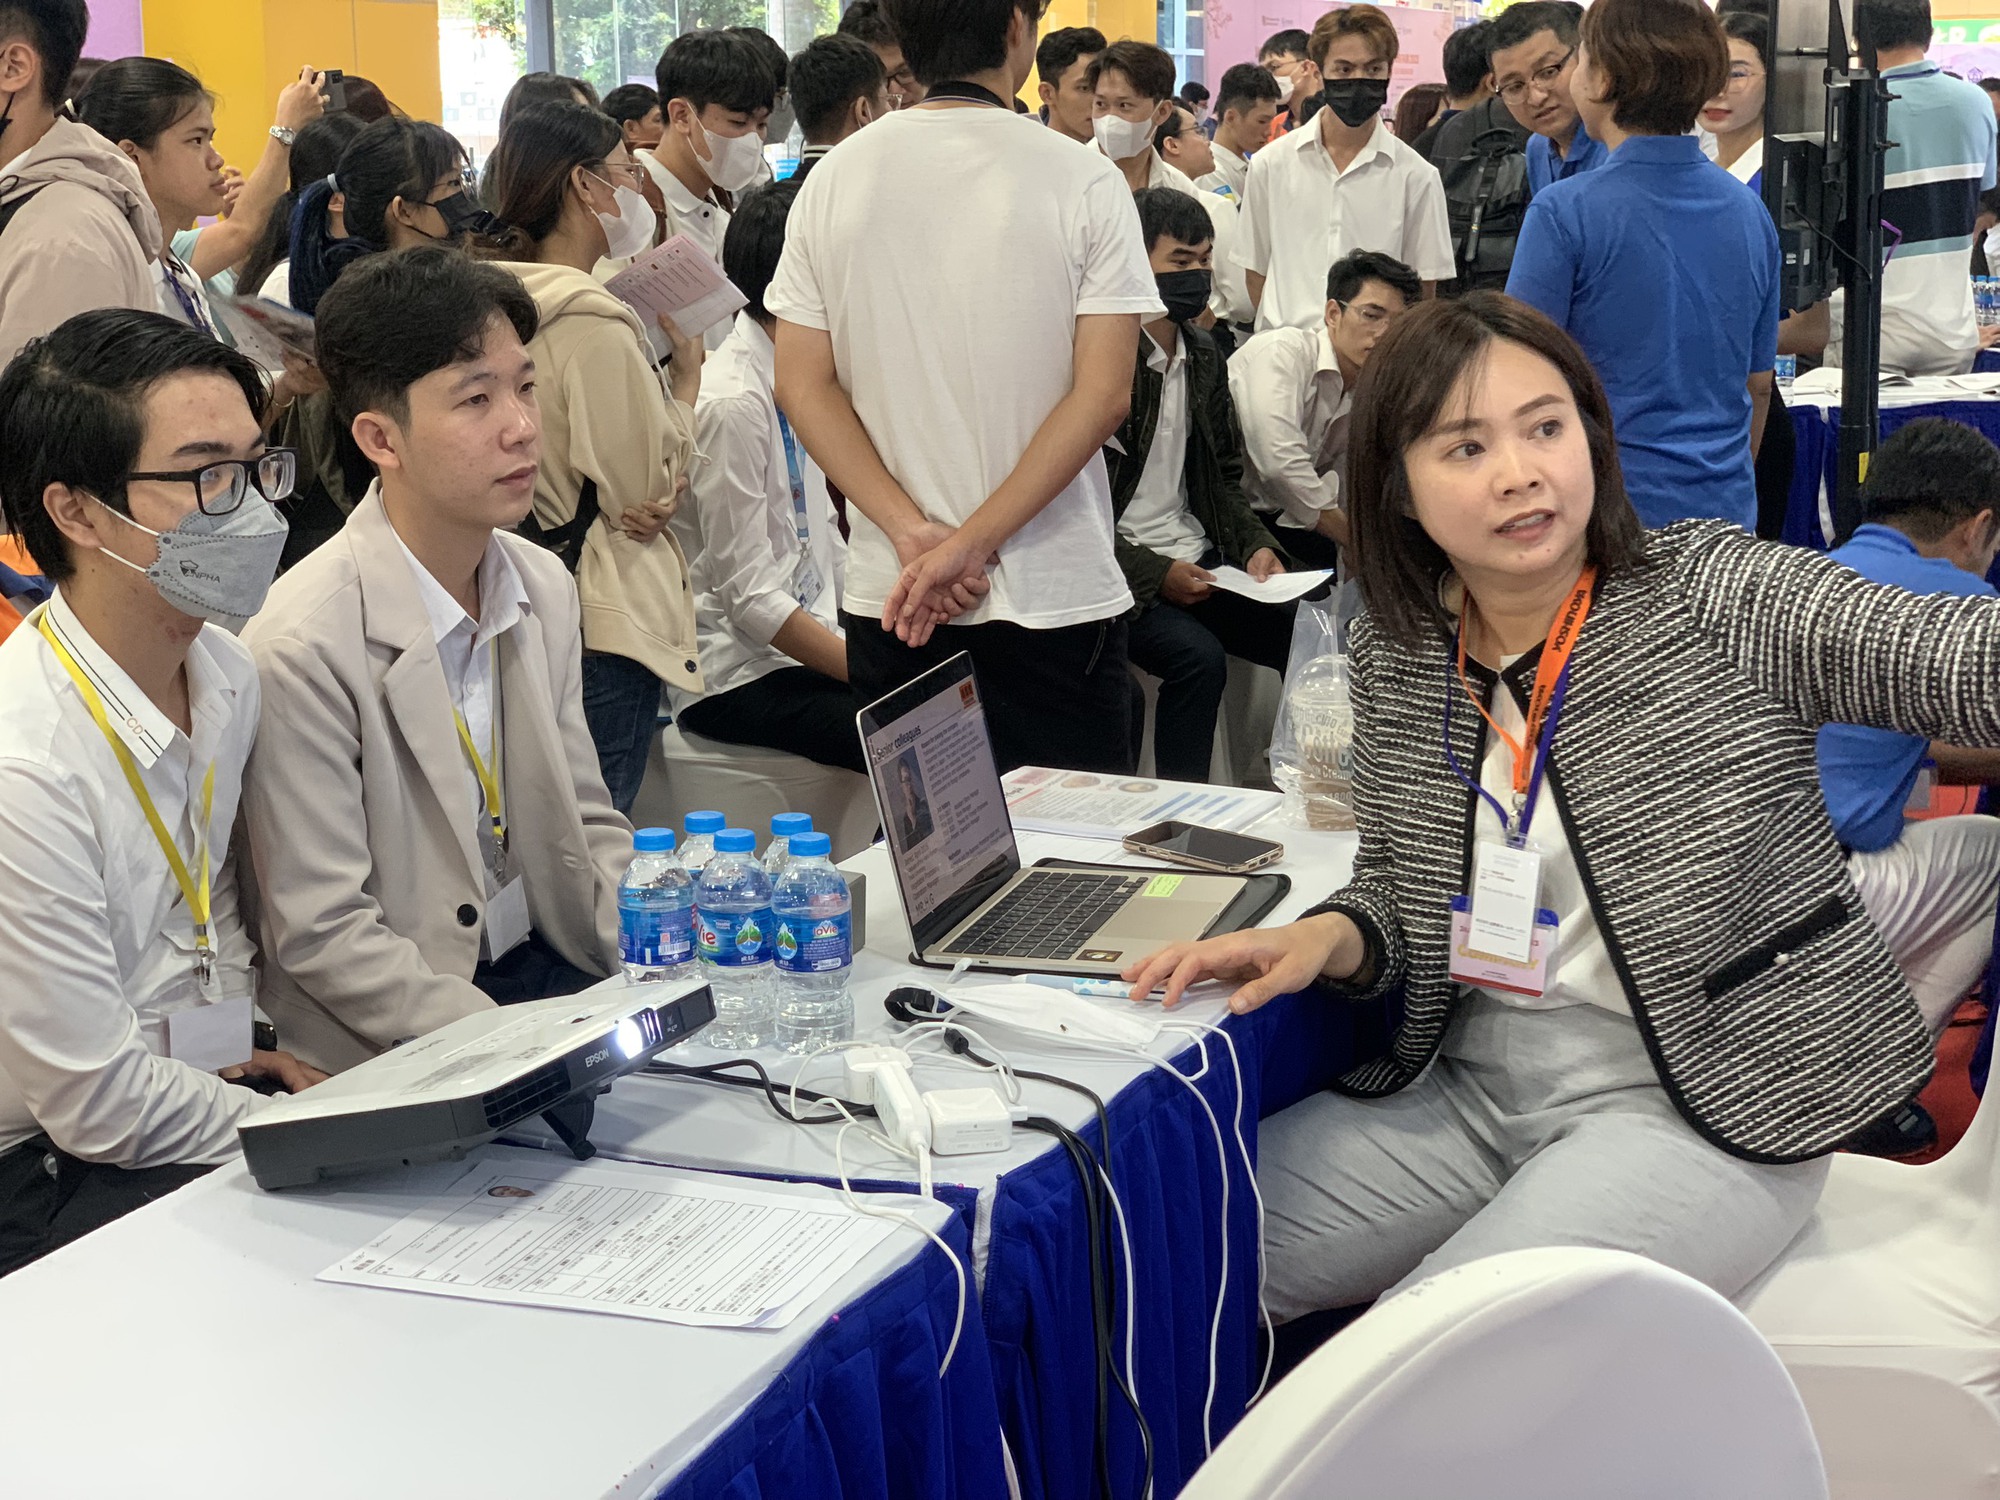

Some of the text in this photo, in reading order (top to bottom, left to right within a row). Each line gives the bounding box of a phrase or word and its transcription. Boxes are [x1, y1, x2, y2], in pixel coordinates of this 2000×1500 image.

[1552, 589, 1587, 652] YOSHINOYA
[126, 717, 144, 736] CD
[877, 725, 922, 760] Senior colleagues
[585, 1048, 610, 1068] EPSON
